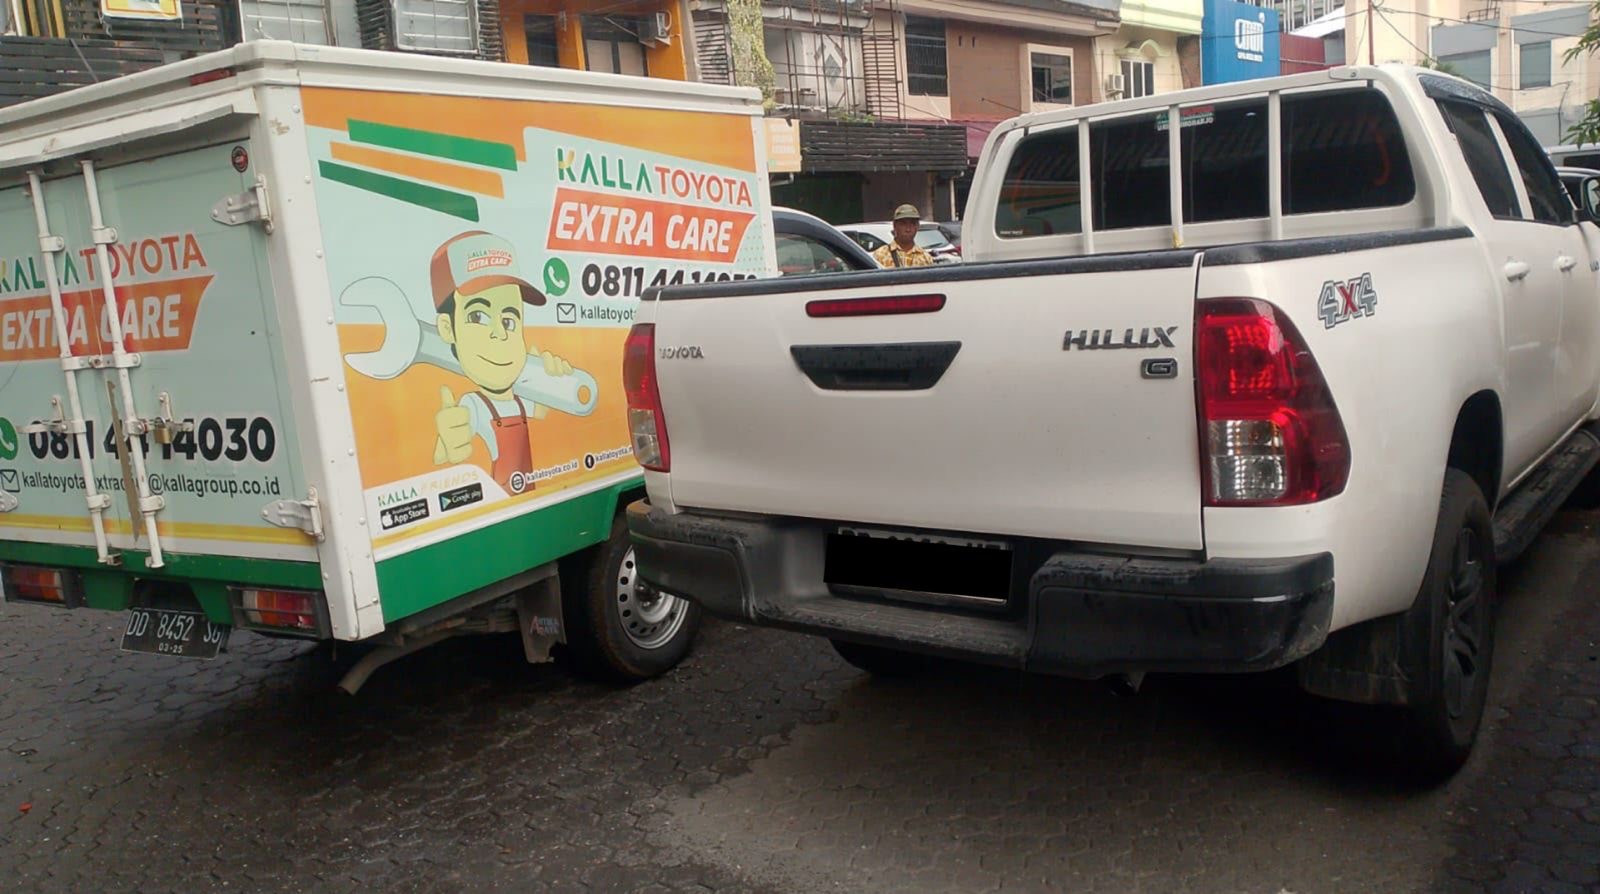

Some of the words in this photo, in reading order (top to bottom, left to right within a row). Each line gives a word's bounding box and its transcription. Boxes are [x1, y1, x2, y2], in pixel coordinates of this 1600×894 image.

[654, 166, 753, 208] TOYOTA
[555, 201, 654, 248] EXTRA
[665, 214, 733, 254] CARE
[0, 251, 80, 293] KALA
[581, 263, 645, 297] 0811
[580, 305, 636, 323] kallatoyot
[1062, 326, 1178, 351] HILUX
[659, 346, 704, 359] TOYOTA
[1143, 359, 1177, 378] G
[394, 513, 409, 524] App
[408, 509, 427, 519] Store
[127, 611, 149, 636] DD
[157, 614, 194, 641] 8452
